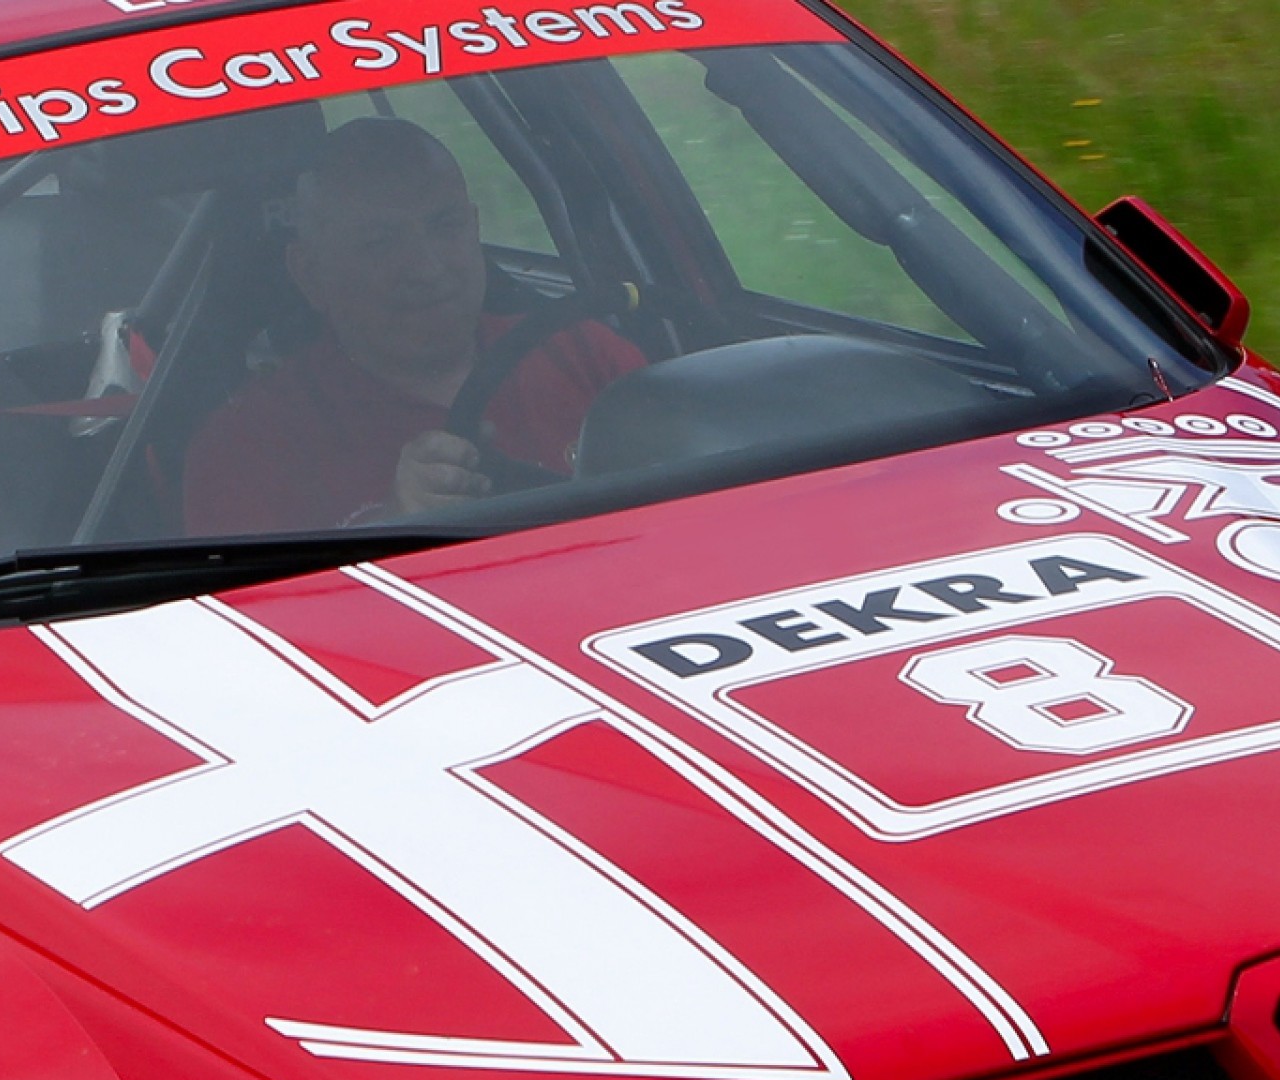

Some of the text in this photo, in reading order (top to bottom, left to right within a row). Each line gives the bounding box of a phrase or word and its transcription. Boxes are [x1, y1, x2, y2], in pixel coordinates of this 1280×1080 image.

[148, 42, 321, 99] Car
[329, 0, 704, 74] Systems
[630, 554, 1150, 679] DEKRA
[897, 635, 1196, 757] 8
